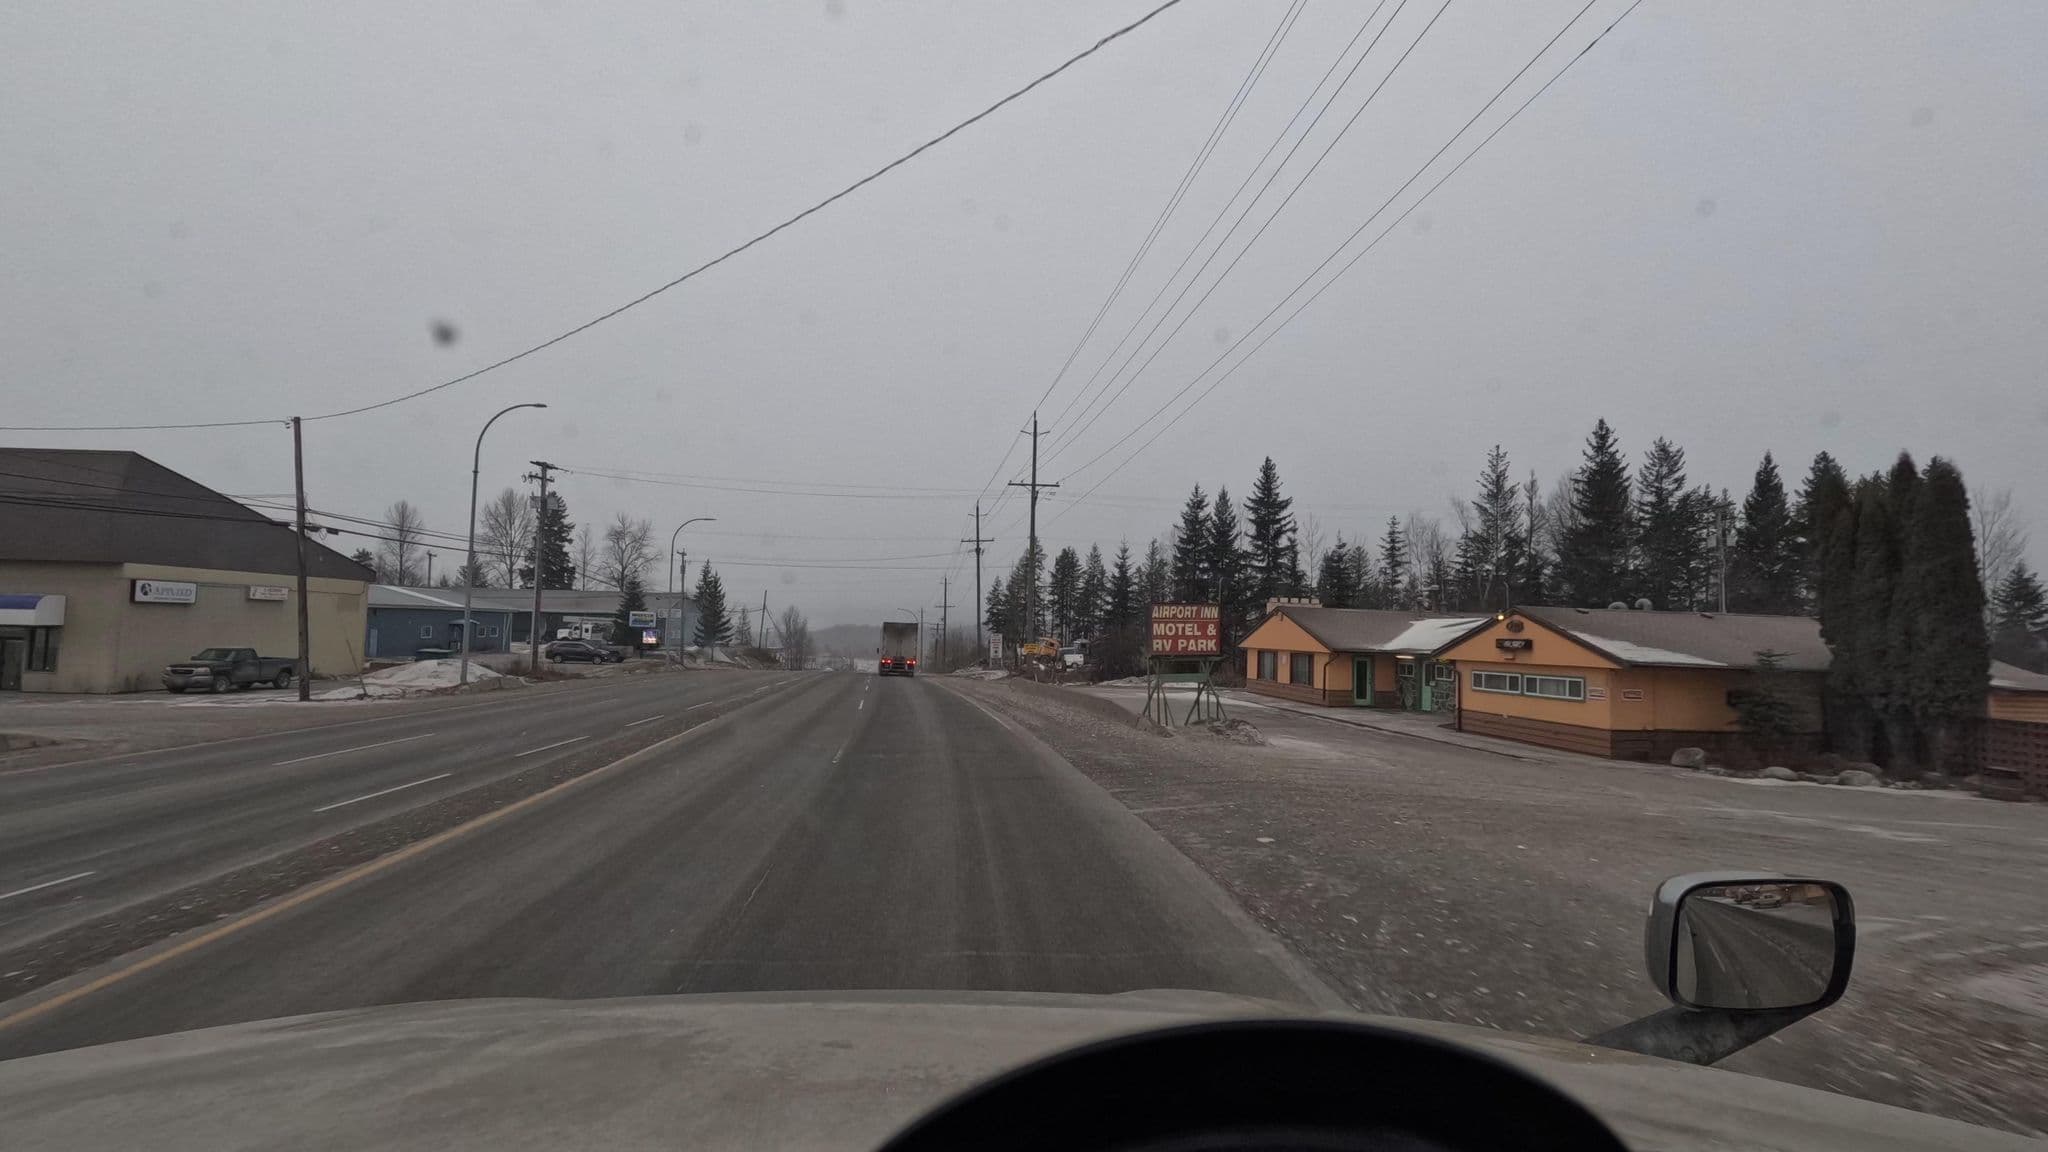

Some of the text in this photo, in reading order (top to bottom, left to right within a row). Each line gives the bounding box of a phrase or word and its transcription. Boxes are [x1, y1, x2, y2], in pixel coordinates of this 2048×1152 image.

[1152, 606, 1219, 619] AIRPORT INN
[1153, 623, 1216, 636] MOTEL &
[1152, 639, 1216, 651] RV PARK
